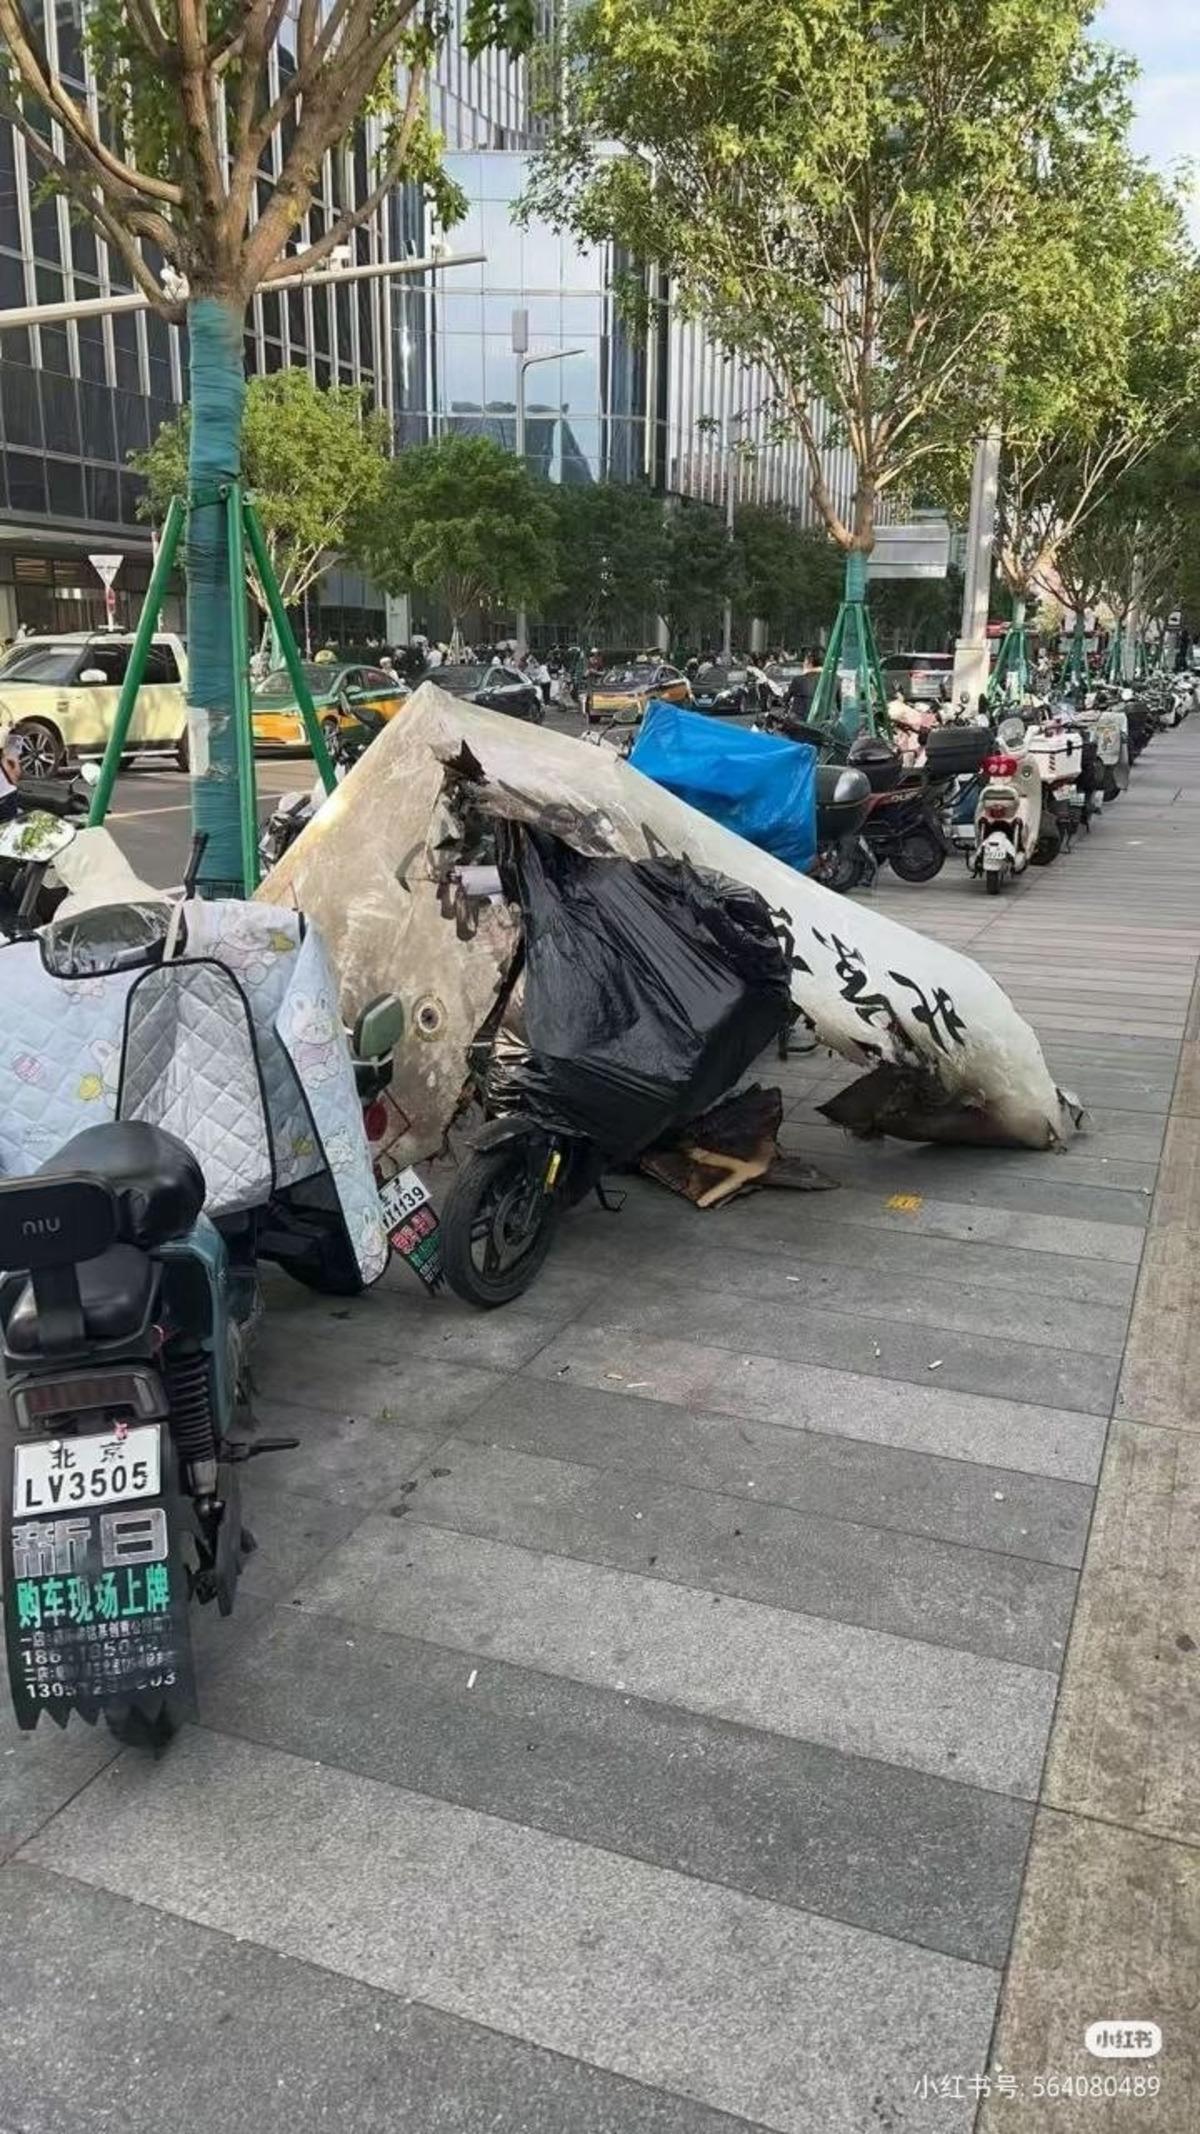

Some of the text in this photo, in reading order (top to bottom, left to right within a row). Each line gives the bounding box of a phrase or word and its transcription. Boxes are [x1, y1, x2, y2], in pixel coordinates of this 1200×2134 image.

[50, 1441, 126, 1469] 北京
[26, 1461, 148, 1507] LV3505
[12, 1507, 169, 1579] 新日
[17, 1563, 170, 1629] 购车现场上牌
